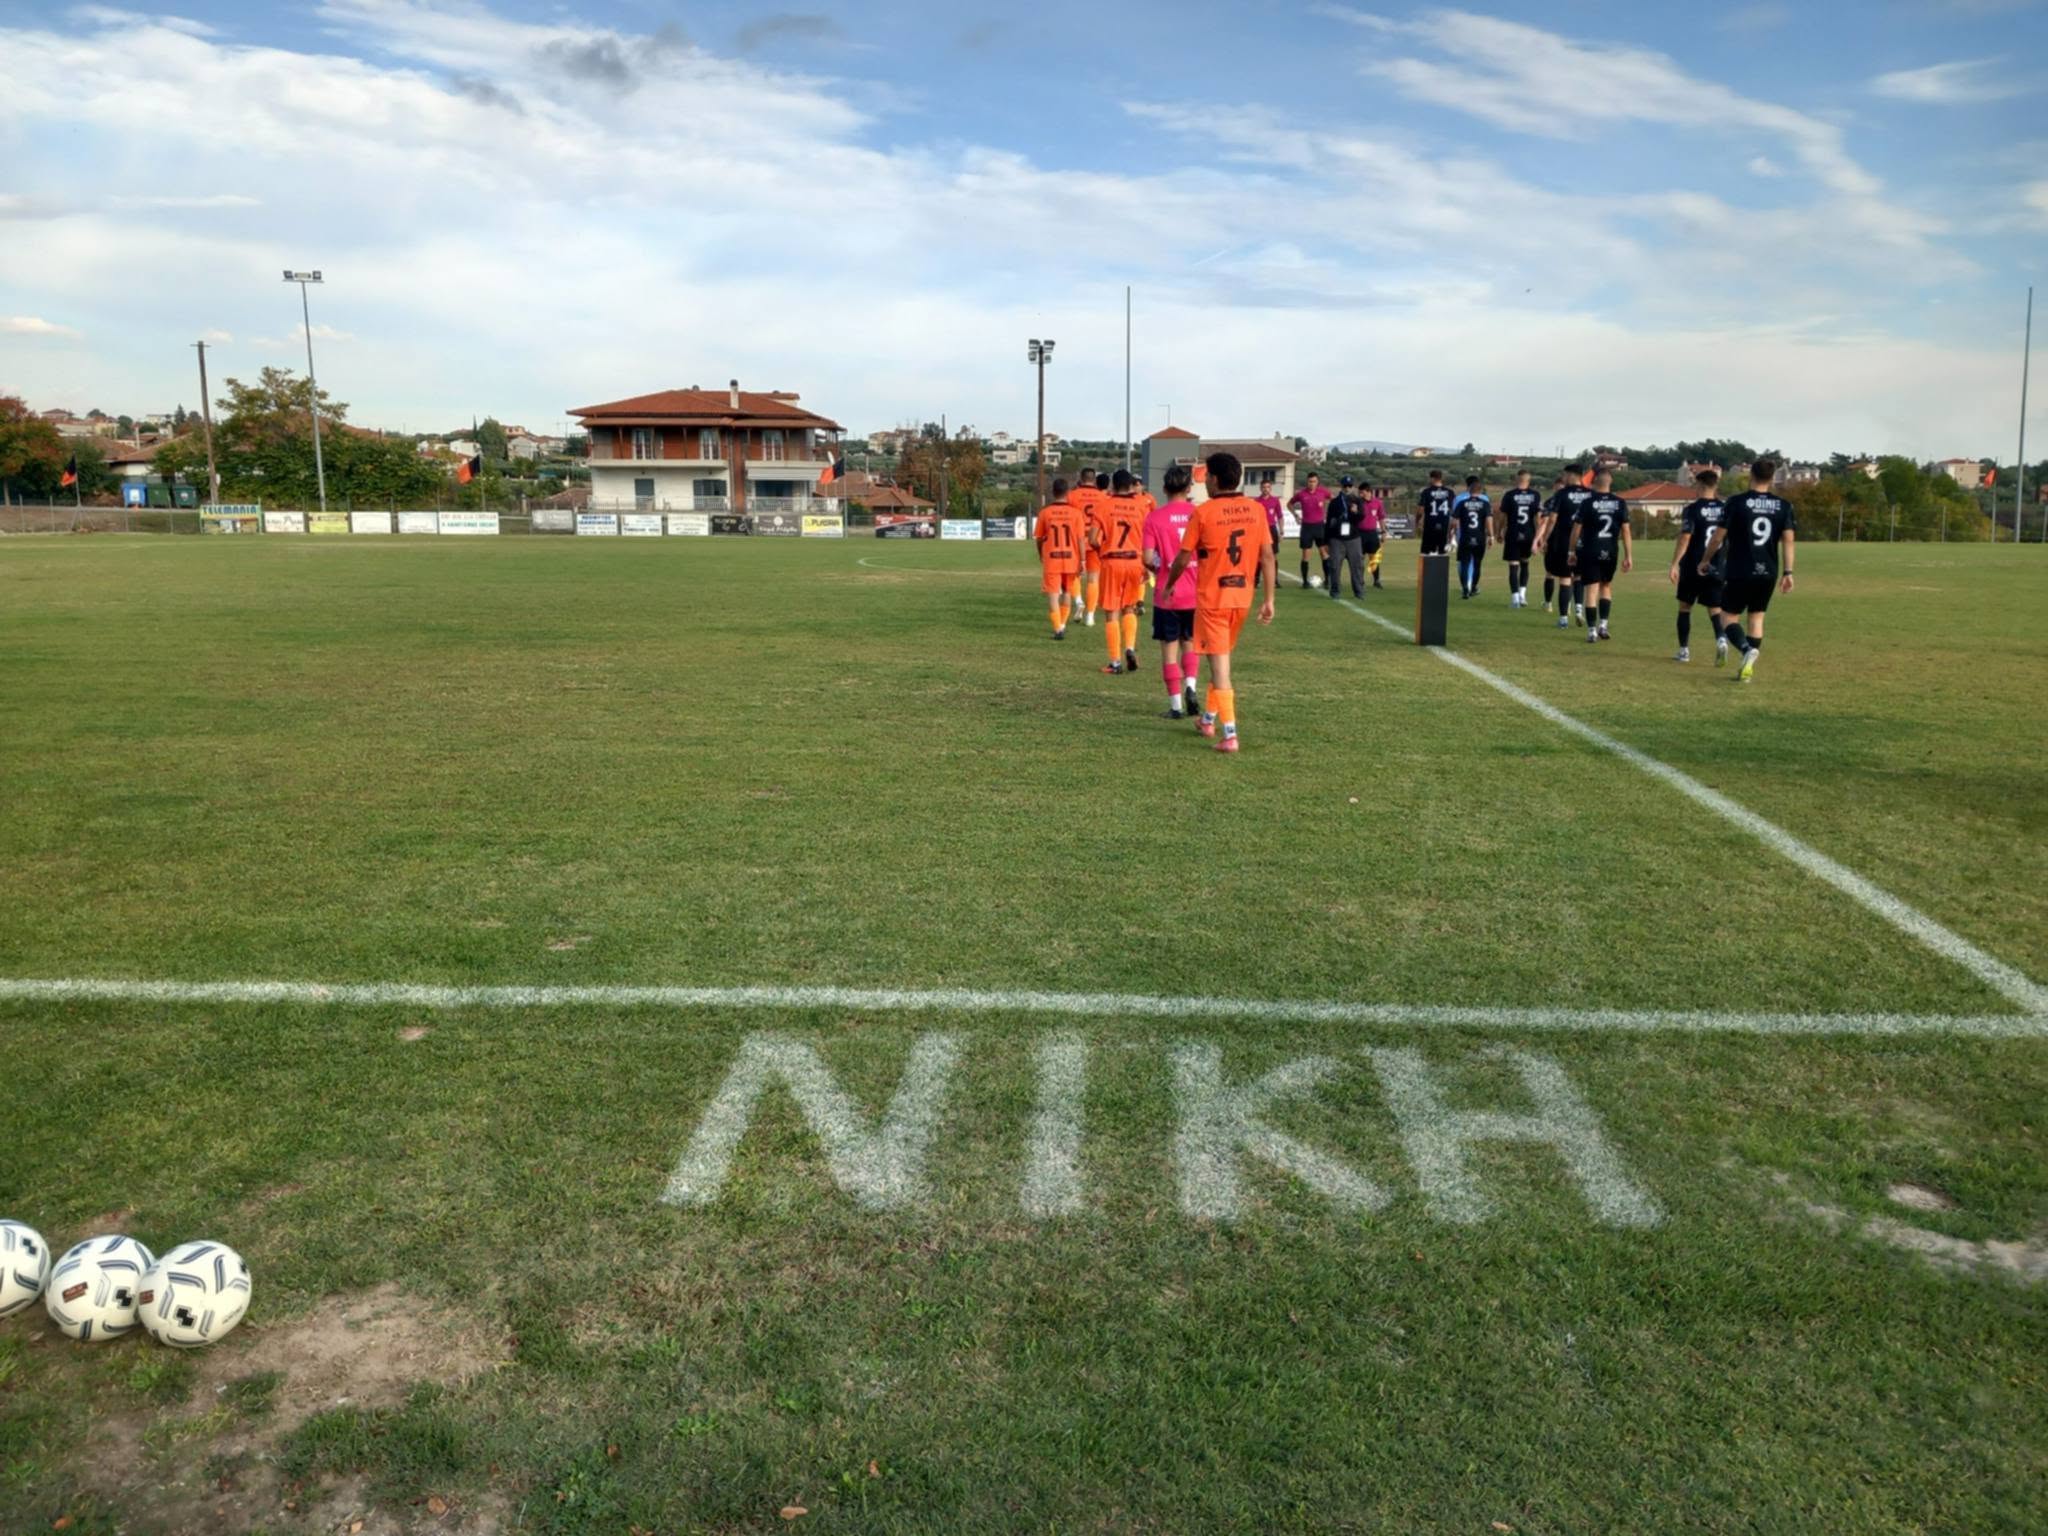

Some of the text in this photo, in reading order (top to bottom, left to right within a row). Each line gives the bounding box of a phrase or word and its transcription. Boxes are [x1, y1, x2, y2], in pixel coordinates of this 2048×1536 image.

[1169, 514, 1188, 523] ΝΙΚ
[1429, 501, 1449, 516] 14
[1468, 511, 1479, 529] 3
[1517, 506, 1530, 525] 5
[1050, 524, 1071, 548] 11
[1117, 521, 1131, 549] 7
[1598, 515, 1613, 538] 2
[1752, 516, 1772, 546] 9
[1226, 529, 1246, 567] 6
